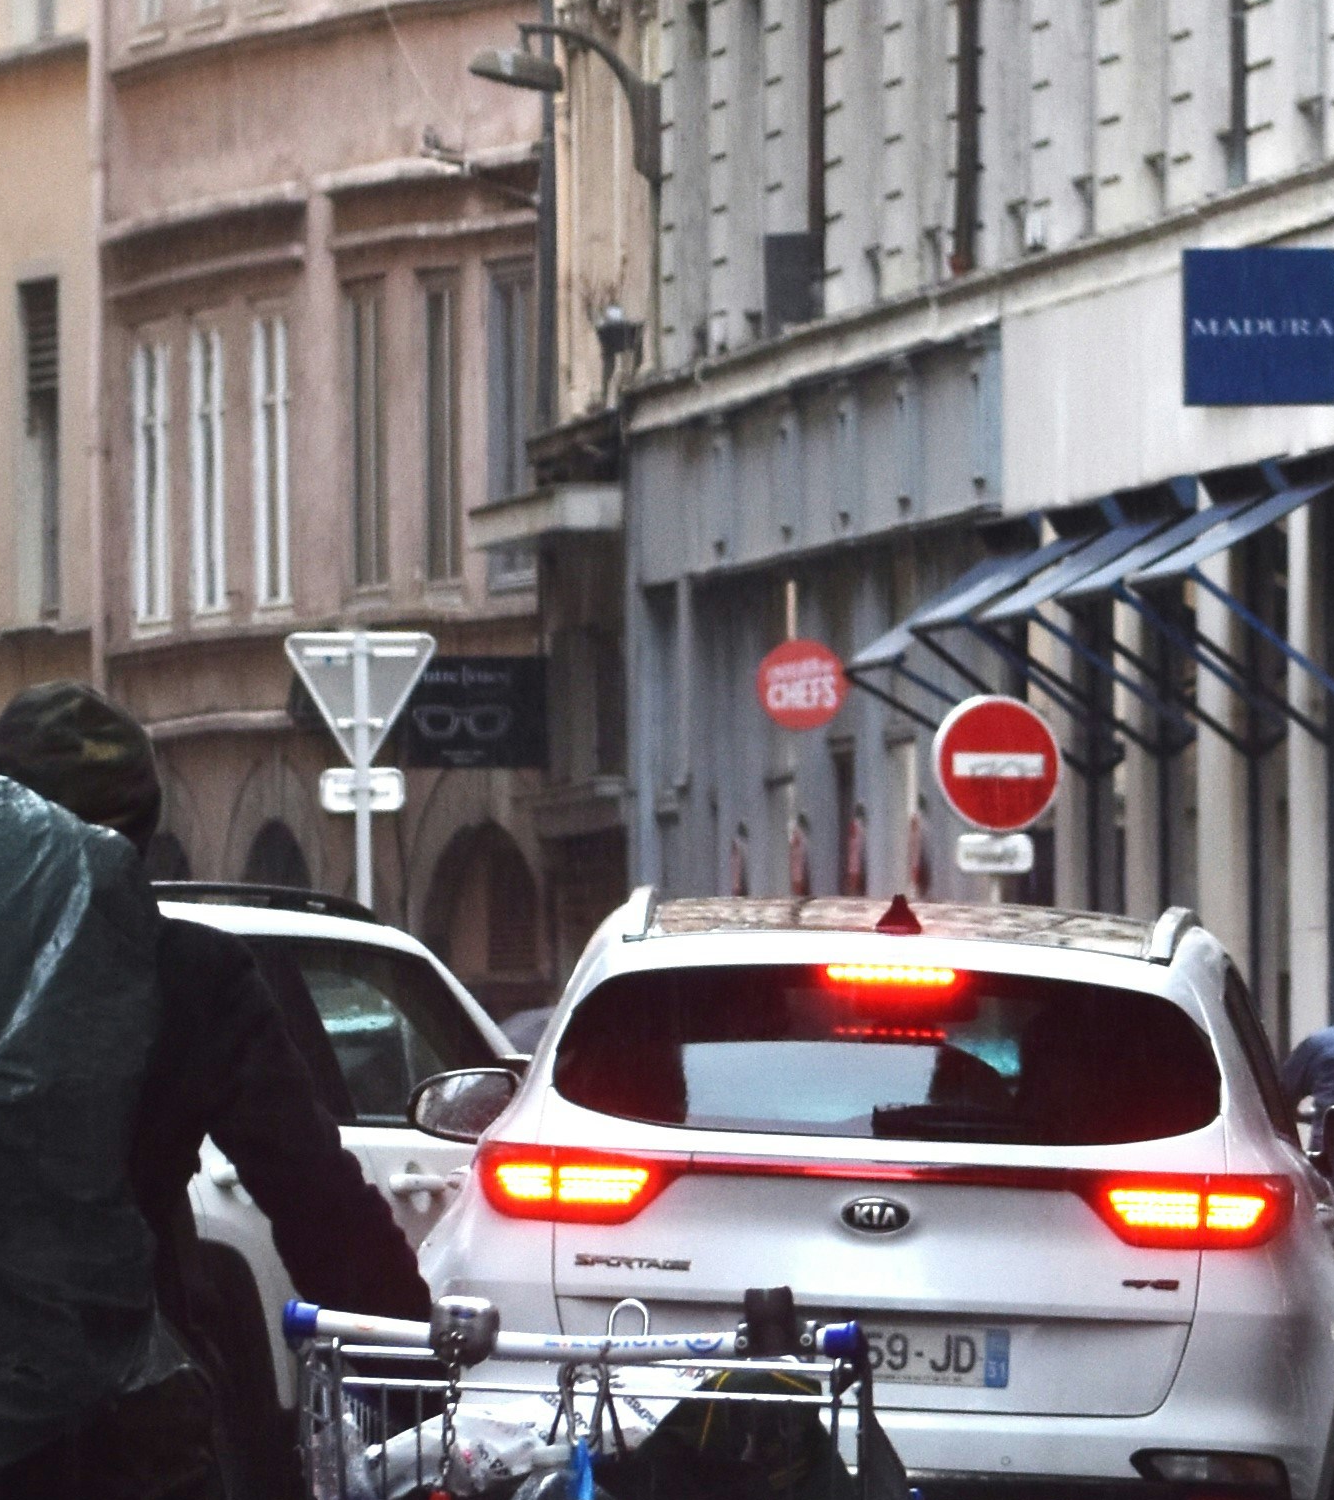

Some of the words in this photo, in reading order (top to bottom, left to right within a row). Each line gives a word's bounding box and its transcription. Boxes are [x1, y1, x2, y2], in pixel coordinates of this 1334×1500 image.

[1192, 317, 1334, 336] MADURA
[767, 674, 837, 710] CHEFS
[854, 1204, 898, 1227] KIA
[574, 1252, 692, 1272] SPORTAGE
